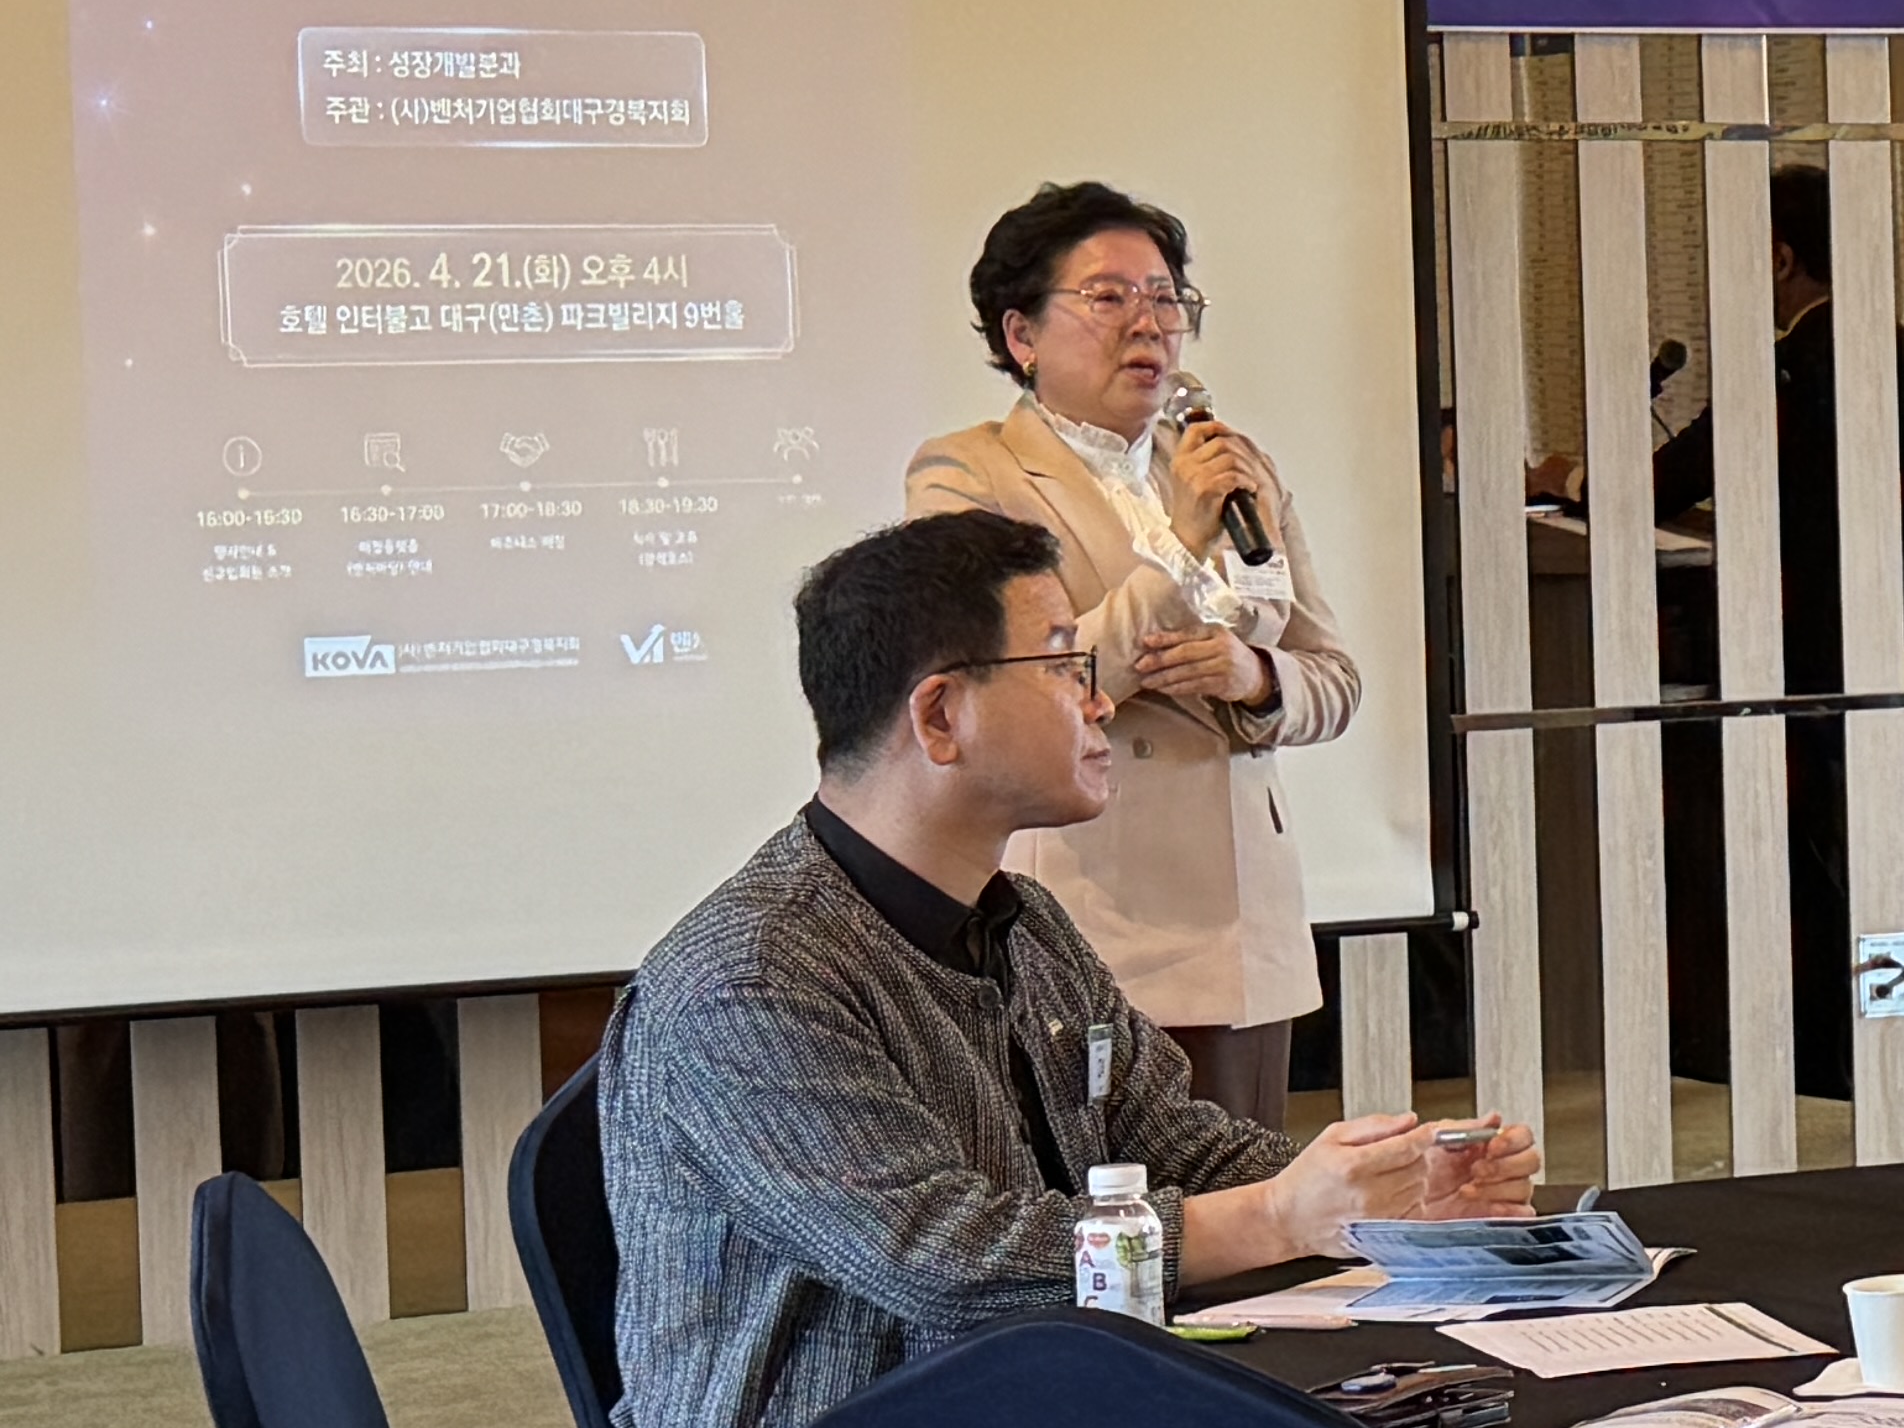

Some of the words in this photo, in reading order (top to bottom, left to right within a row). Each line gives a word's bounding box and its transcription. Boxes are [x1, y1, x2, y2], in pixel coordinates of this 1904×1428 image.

[323, 49, 369, 79] 주최
[325, 95, 370, 125] 주관
[335, 257, 421, 290] 2026.
[428, 252, 461, 289] 4.
[579, 254, 635, 290] 오후
[643, 254, 689, 288] 4시
[279, 302, 328, 335] 호텔
[335, 302, 431, 335] 인터불고
[560, 300, 678, 331] 파크빌리지
[311, 650, 389, 672] KOVA
